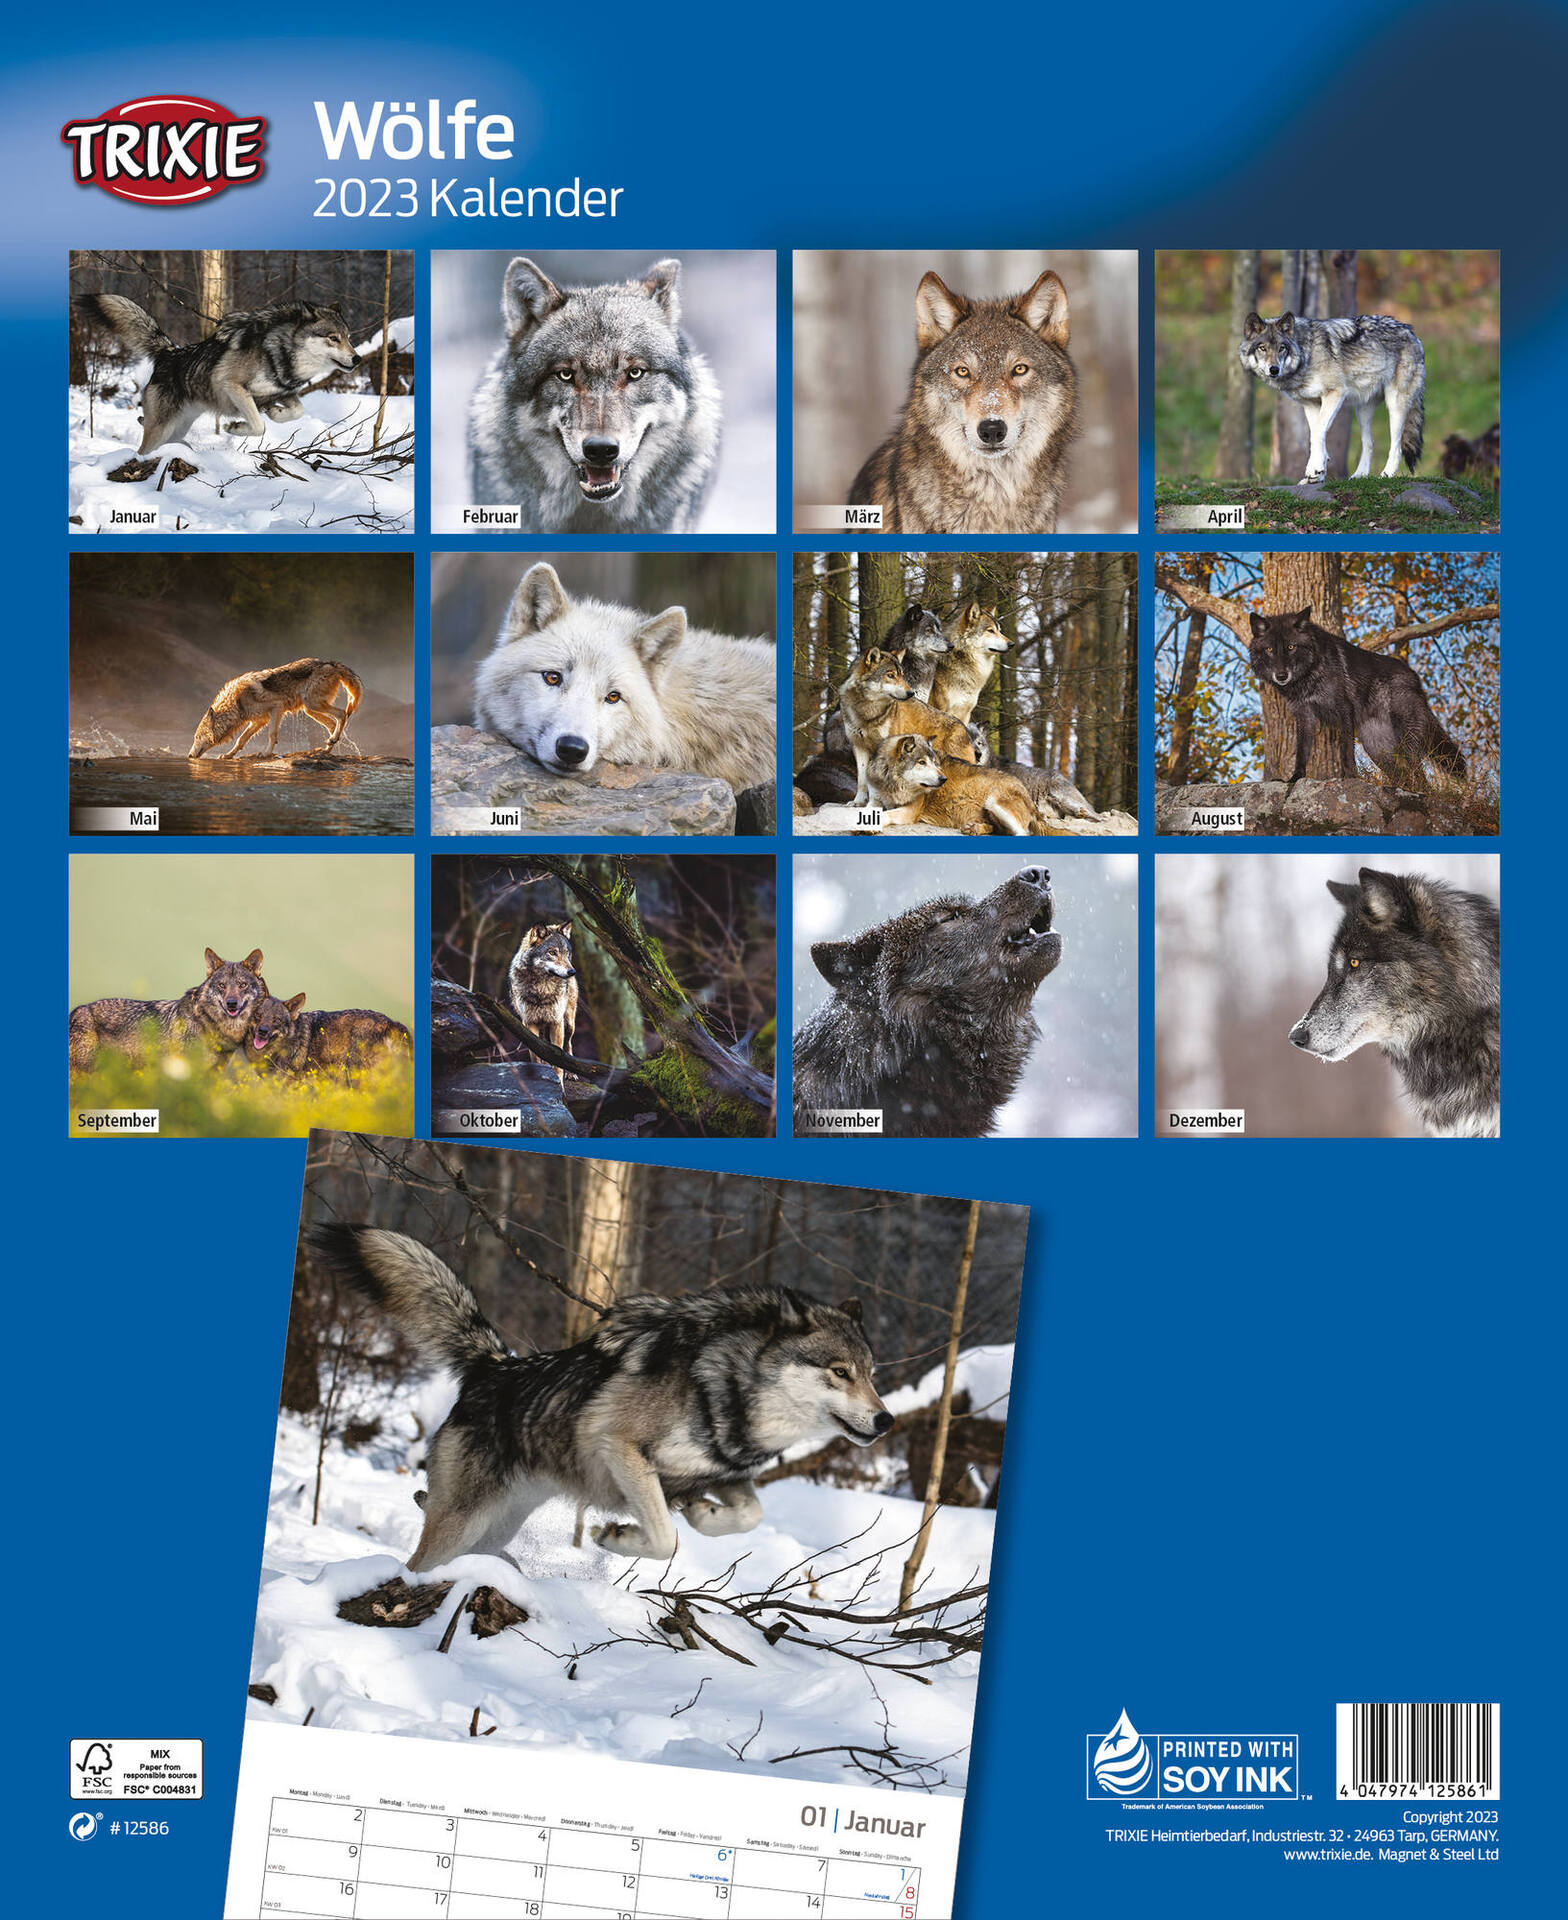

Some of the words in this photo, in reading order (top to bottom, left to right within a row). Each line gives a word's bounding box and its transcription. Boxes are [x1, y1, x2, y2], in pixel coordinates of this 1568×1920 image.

[314, 99, 515, 161] Wölfe
[67, 121, 261, 181] TRIXIE
[312, 177, 418, 217] 2023
[430, 177, 624, 217] Kalender
[109, 509, 157, 524] Januar
[463, 509, 519, 524] Februar
[845, 509, 881, 524] März
[1207, 509, 1244, 527] April
[130, 812, 157, 826] Mai
[490, 812, 519, 826] Juni
[856, 812, 881, 826] Juli
[1191, 812, 1244, 829] August
[78, 1113, 157, 1130] September
[460, 1113, 519, 1127] Oktober
[806, 1113, 880, 1127] November
[1169, 1113, 1243, 1127] Dezember
[150, 1749, 171, 1759] MIX
[1163, 1741, 1242, 1758] PRINTED
[1248, 1741, 1294, 1758] WITH
[140, 1763, 162, 1772] Paper
[163, 1763, 181, 1771] from
[82, 1777, 112, 1787] FSC
[1163, 1766, 1230, 1793] SOY
[1236, 1766, 1293, 1793] INK
[152, 1785, 196, 1794] C004831
[1339, 1784, 1348, 1797] 4
[1358, 1784, 1418, 1797] 047974
[1428, 1784, 1486, 1797] 125861
[463, 1807, 488, 1816] Mittwoch
[1196, 1803, 1225, 1811] Soybean
[353, 1808, 363, 1821] 2
[800, 1805, 827, 1828] 01
[844, 1810, 926, 1838] Januar
[1403, 1810, 1463, 1825] Copyright
[1466, 1810, 1499, 1823] 2023
[445, 1818, 455, 1832] 3
[538, 1829, 547, 1842] 4
[1105, 1829, 1149, 1842] TRIXIE
[1151, 1829, 1250, 1844] Heimtierbedarf,
[1252, 1829, 1326, 1842] Industriestr.
[1329, 1829, 1344, 1842] 32
[1354, 1829, 1395, 1842] 24963
[1397, 1829, 1429, 1844] Tarp,
[1431, 1829, 1499, 1842] GERMANY.
[631, 1838, 640, 1852] 5
[746, 1838, 770, 1848] Samstag
[348, 1845, 358, 1858] 9
[1284, 1848, 1374, 1861] www.trixie.de.
[1378, 1848, 1427, 1863] Magnet
[1429, 1848, 1440, 1861] &
[1443, 1848, 1476, 1861] Steel
[1478, 1848, 1499, 1861] Ltd
[436, 1855, 451, 1869] 10
[817, 1859, 826, 1872] 7
[533, 1866, 544, 1878] 11
[900, 1868, 905, 1880] 1
[339, 1882, 354, 1896] 16
[622, 1875, 636, 1889] 12
[434, 1892, 448, 1905] 17
[715, 1885, 729, 1899] 13
[905, 1886, 915, 1900] 8
[525, 1902, 540, 1916] 18
[806, 1895, 821, 1909] 14
[900, 1905, 914, 1919] 15
